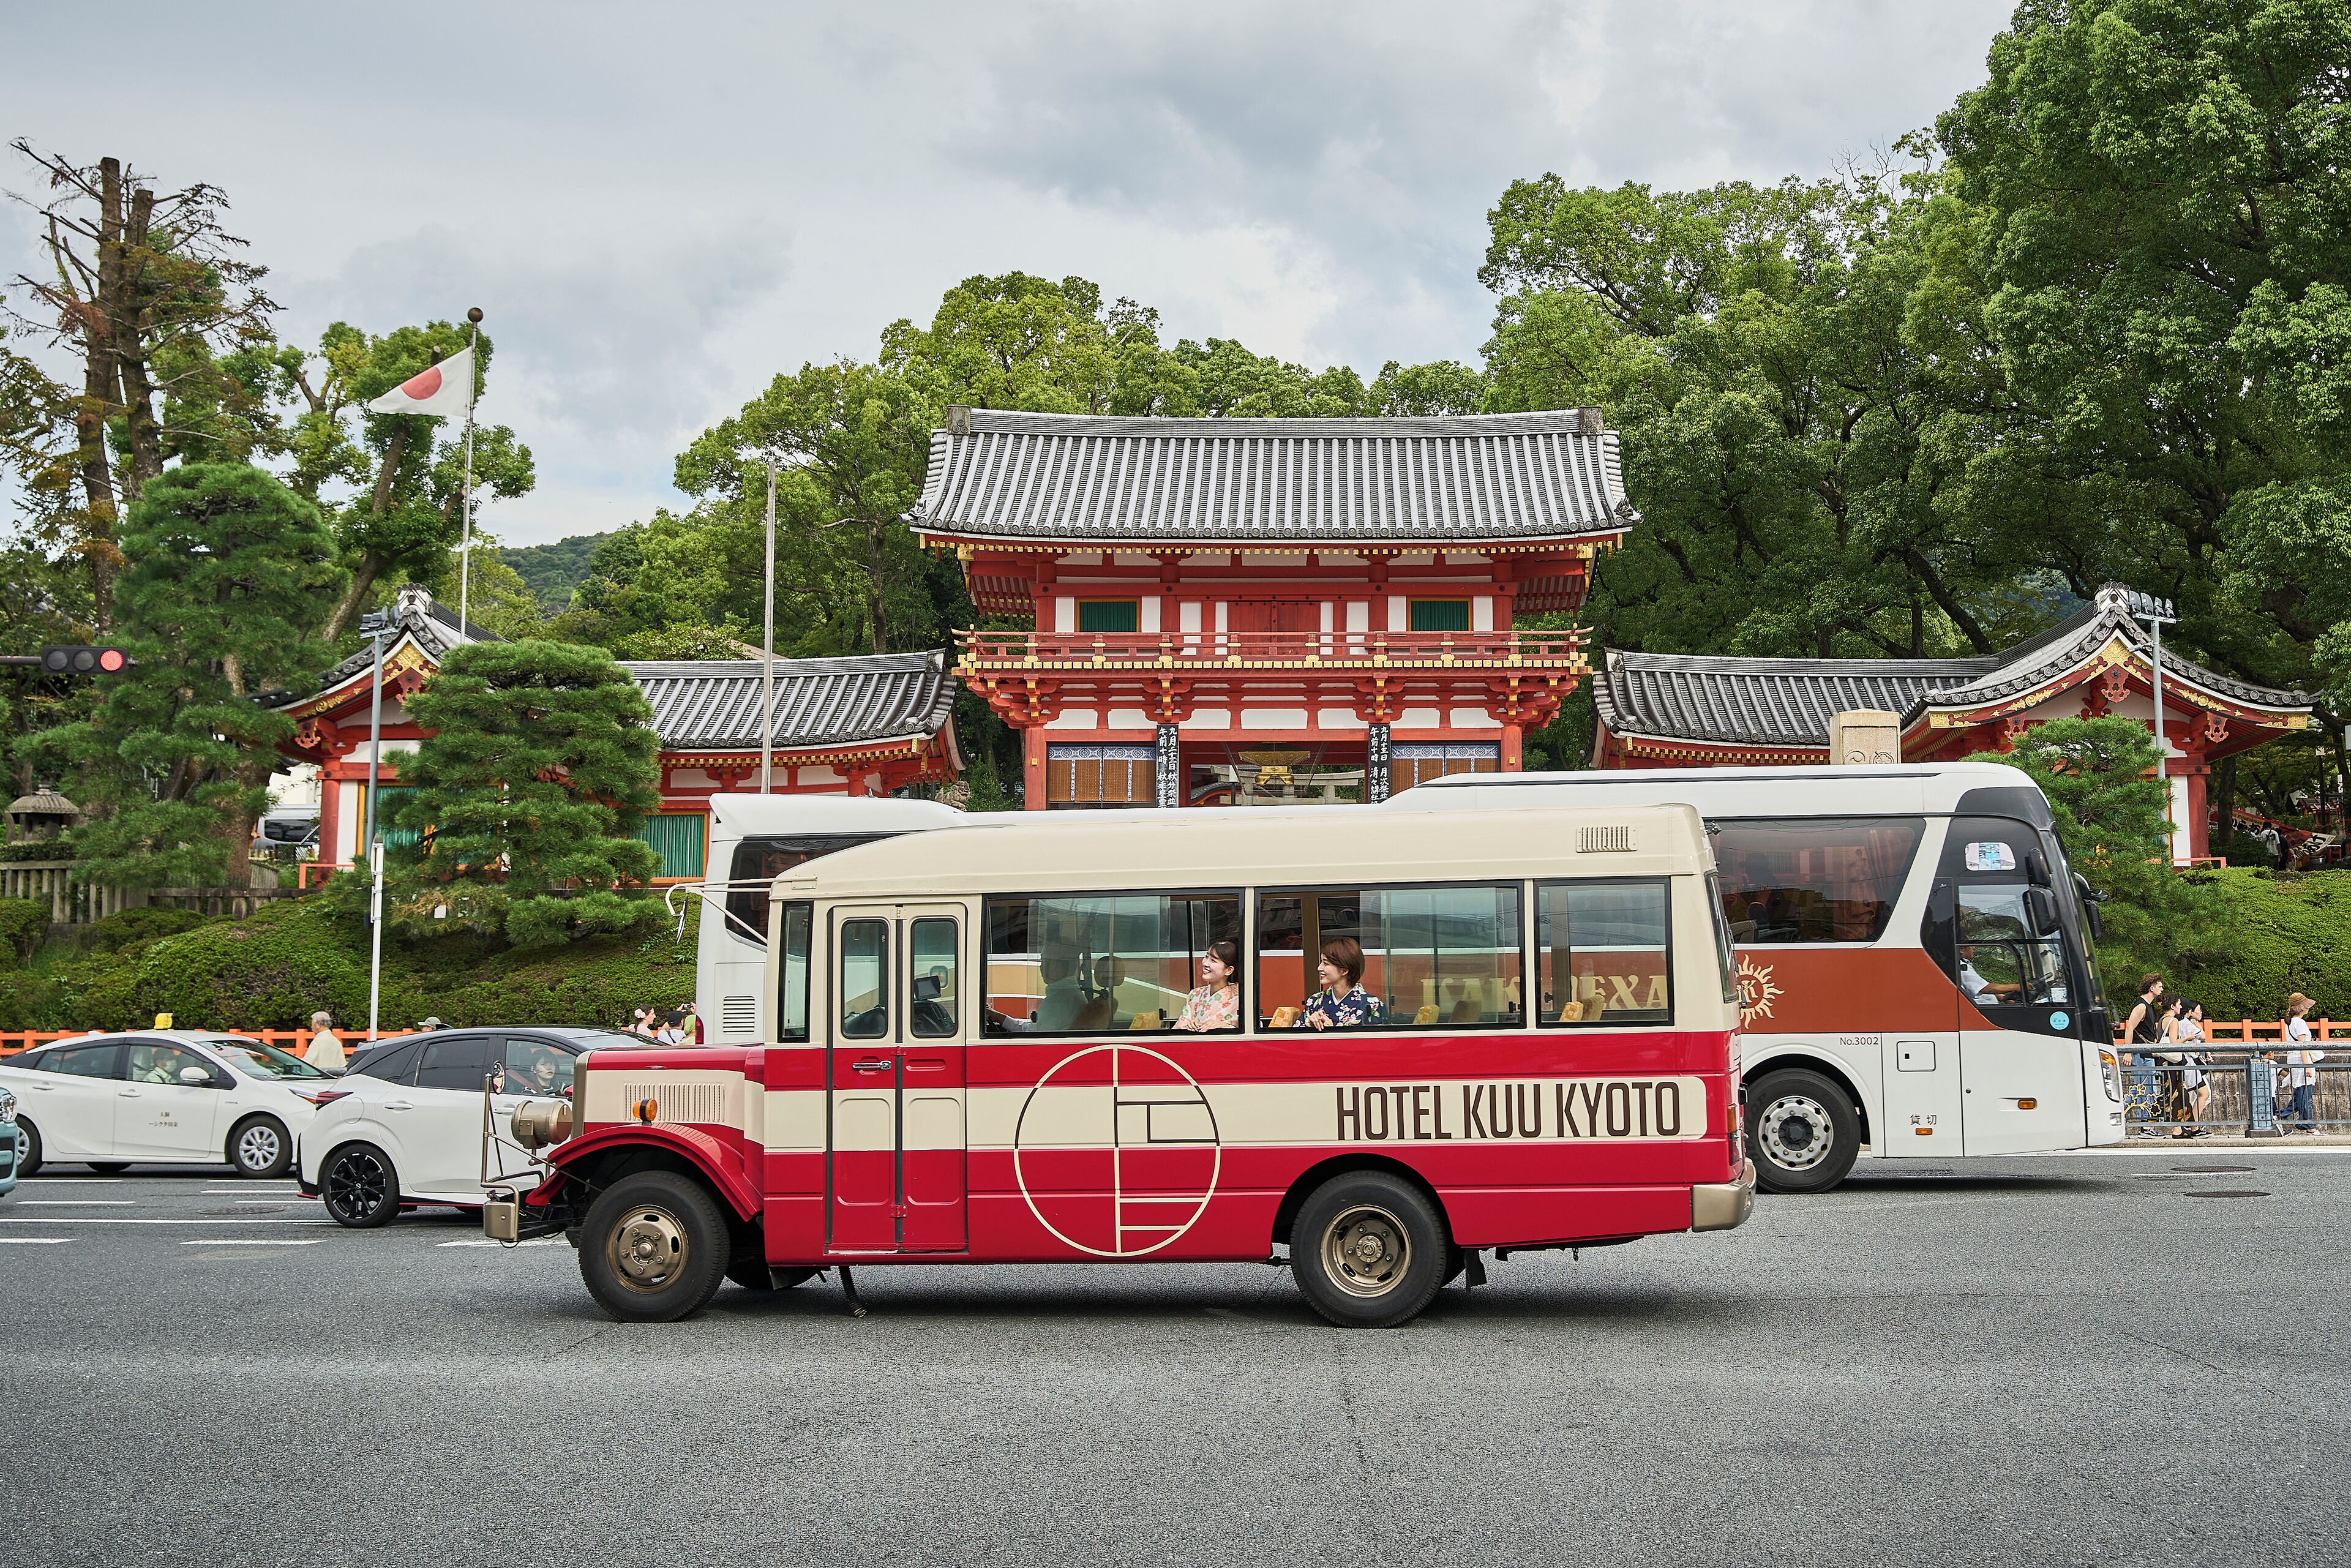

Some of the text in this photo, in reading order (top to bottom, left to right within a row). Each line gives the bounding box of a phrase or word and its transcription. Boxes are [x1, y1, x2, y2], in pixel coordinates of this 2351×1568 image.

[1158, 727, 1168, 765] 午前十時
[1168, 727, 1177, 770] 九月二十三日
[1380, 726, 1389, 761] 九月十五日
[1369, 726, 1380, 804] 午前十時 清々講社
[1337, 1082, 1680, 1140] HOTEL KUU KYOTO
[1910, 1114, 1937, 1125] 貸切
